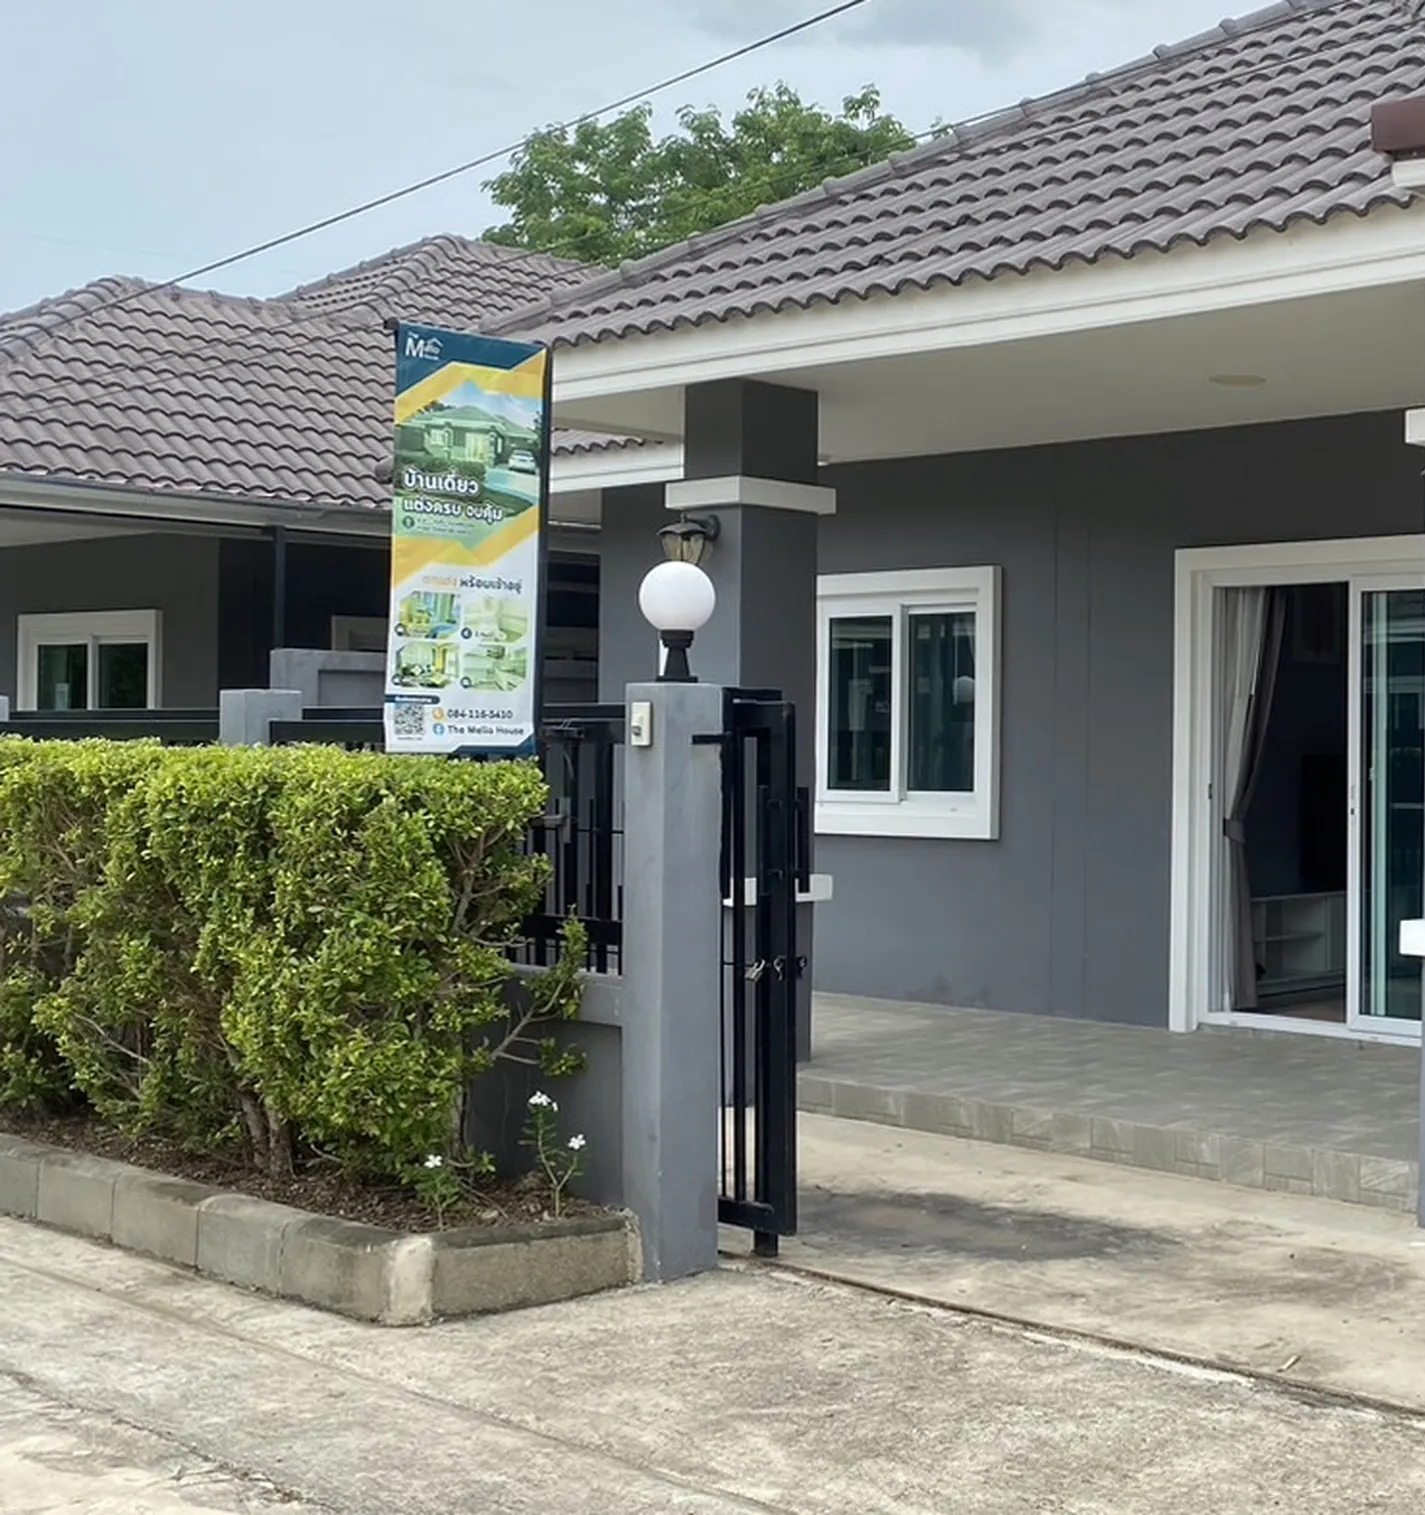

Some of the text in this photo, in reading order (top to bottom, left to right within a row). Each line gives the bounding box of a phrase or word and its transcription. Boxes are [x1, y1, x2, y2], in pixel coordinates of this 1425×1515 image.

[404, 466, 479, 494] บ้านเดี่ยว
[448, 725, 464, 735] The
[496, 726, 524, 736] House
